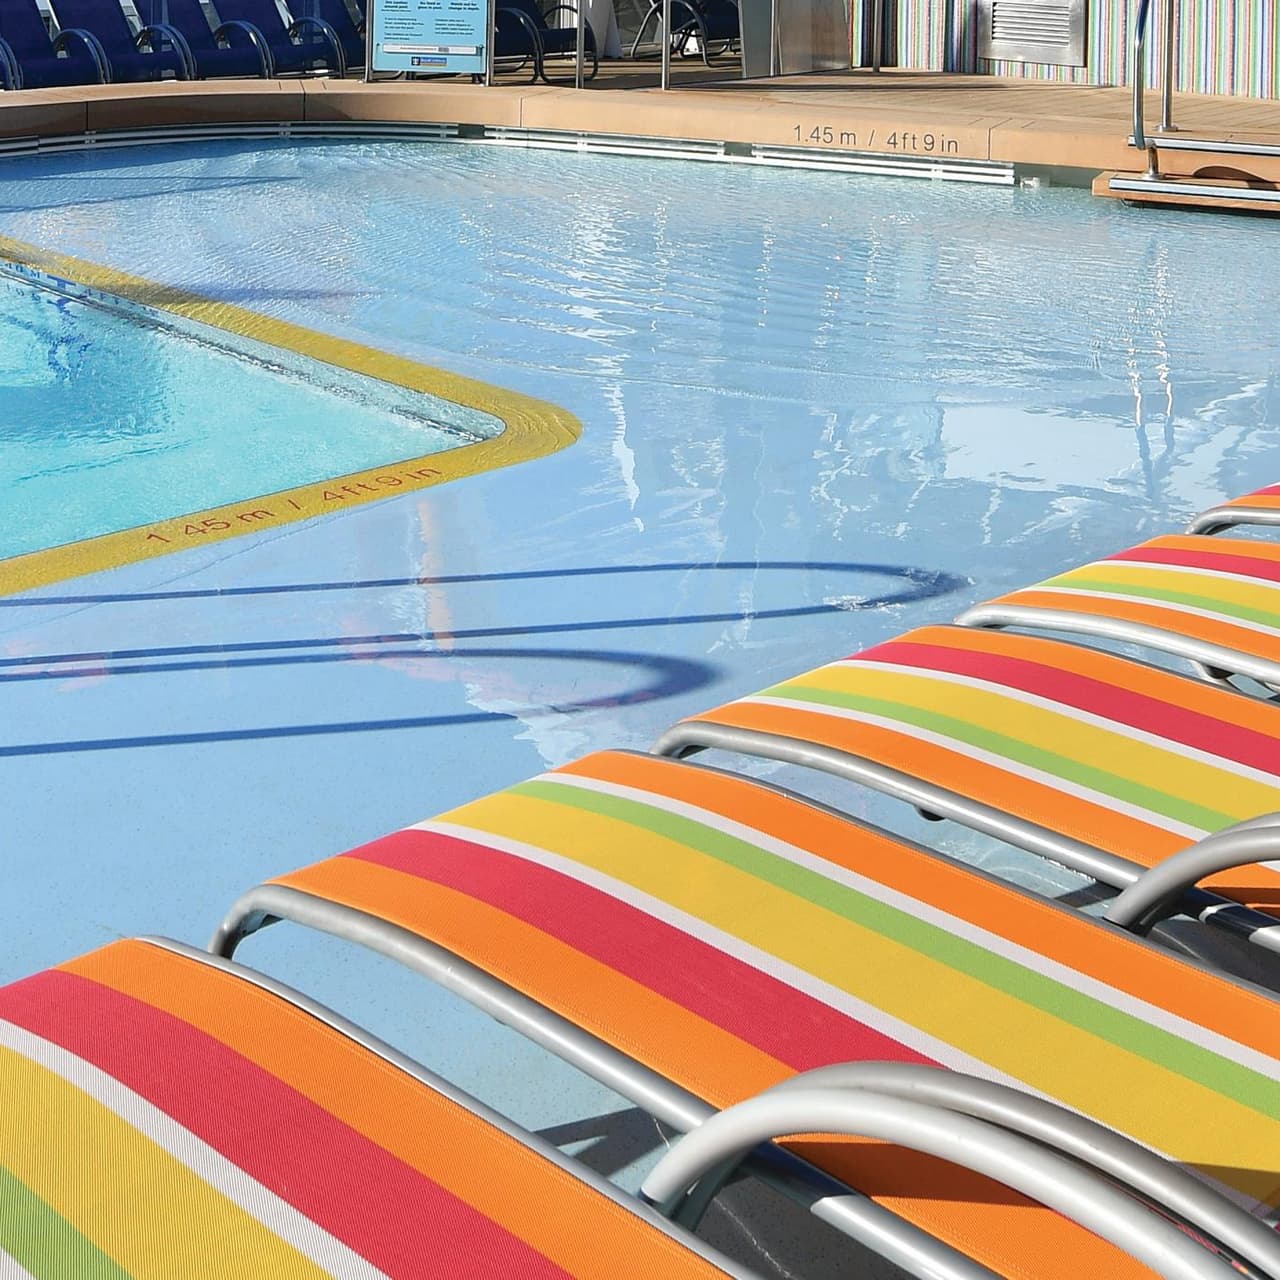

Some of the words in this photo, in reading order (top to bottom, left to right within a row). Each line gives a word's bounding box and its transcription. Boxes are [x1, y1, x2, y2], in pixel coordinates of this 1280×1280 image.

[794, 125, 834, 144] 1.45
[840, 130, 856, 145] m
[868, 129, 875, 146] /
[923, 134, 935, 151] 9
[941, 134, 958, 153] in
[236, 509, 276, 523] m
[375, 475, 402, 486] 9
[399, 468, 441, 480] in
